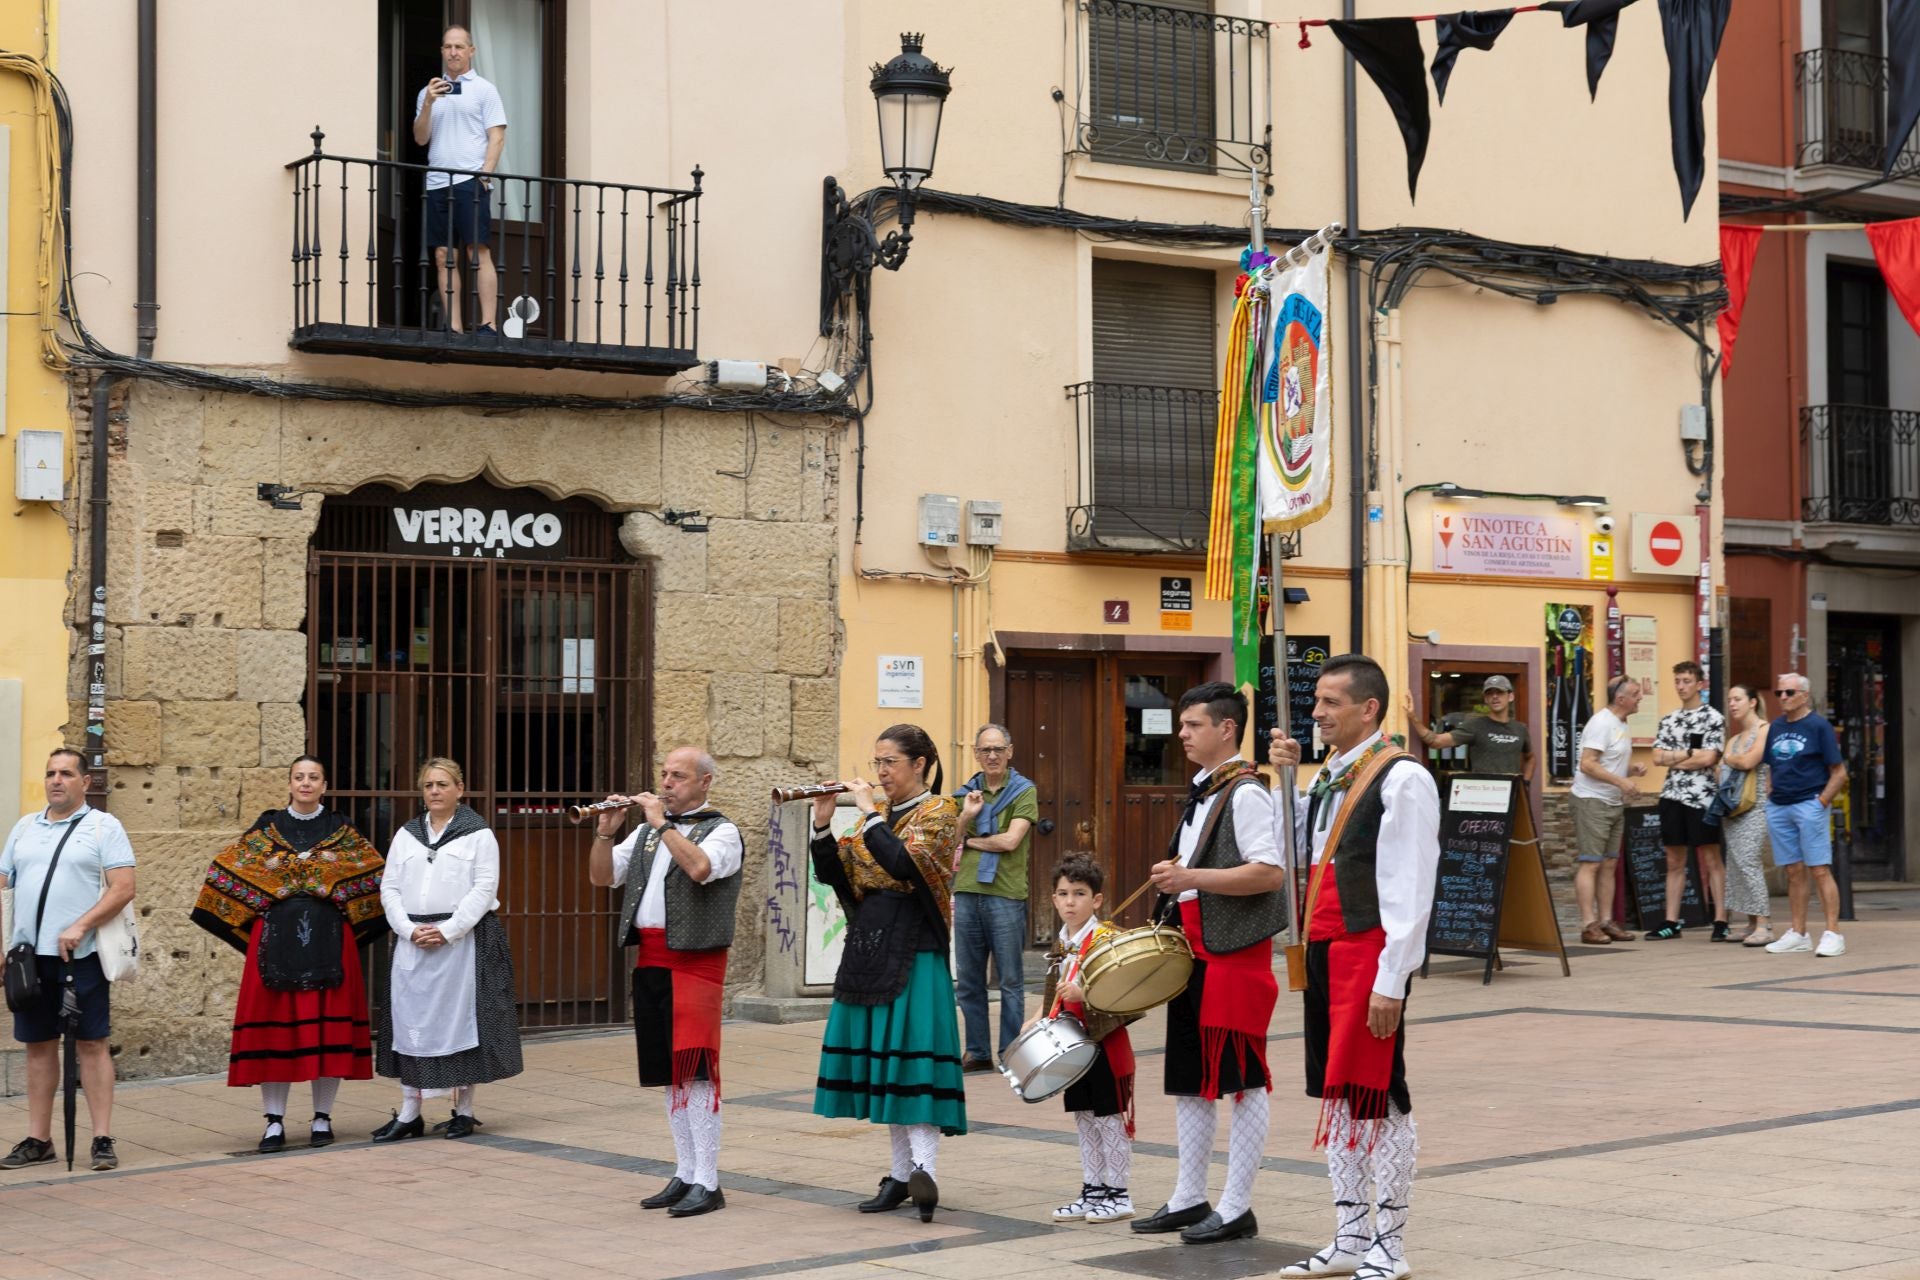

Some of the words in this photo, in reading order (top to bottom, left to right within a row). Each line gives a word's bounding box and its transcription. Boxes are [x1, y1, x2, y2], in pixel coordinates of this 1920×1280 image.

[393, 507, 562, 548] VERRACO
[1462, 517, 1548, 536] VINOTECA
[452, 546, 505, 558] BAR
[1462, 534, 1495, 550] SAN
[1499, 535, 1573, 553] AGUSTÍN
[1459, 820, 1505, 835] OFERTAS
